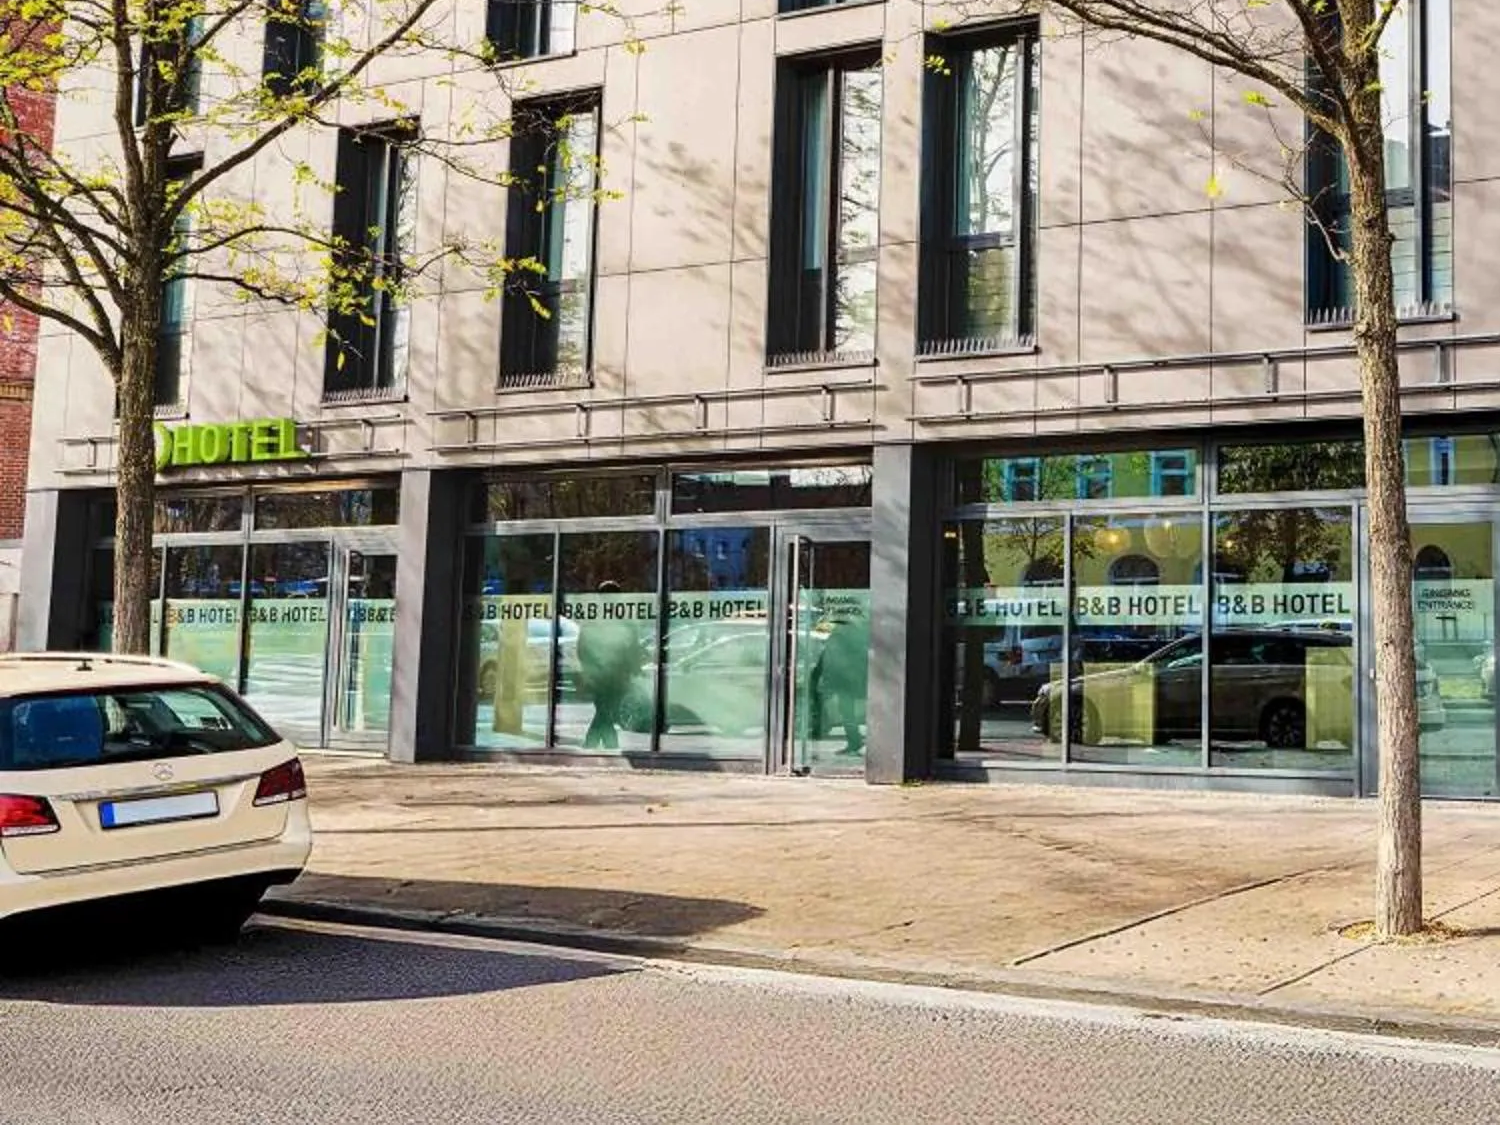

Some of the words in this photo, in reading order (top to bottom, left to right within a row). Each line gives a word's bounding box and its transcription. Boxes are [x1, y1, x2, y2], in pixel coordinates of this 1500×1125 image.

[172, 418, 311, 465] HOTEL
[501, 603, 553, 620] HOTEL
[563, 603, 598, 620] B&B
[603, 602, 657, 620] HOTEL
[1077, 596, 1120, 616] B&B
[1129, 595, 1200, 615] HOTEL
[1217, 595, 1265, 615] B&B
[1274, 593, 1350, 615] HOTEL
[199, 607, 241, 624] HOTEL
[282, 606, 327, 623] HOTEL
